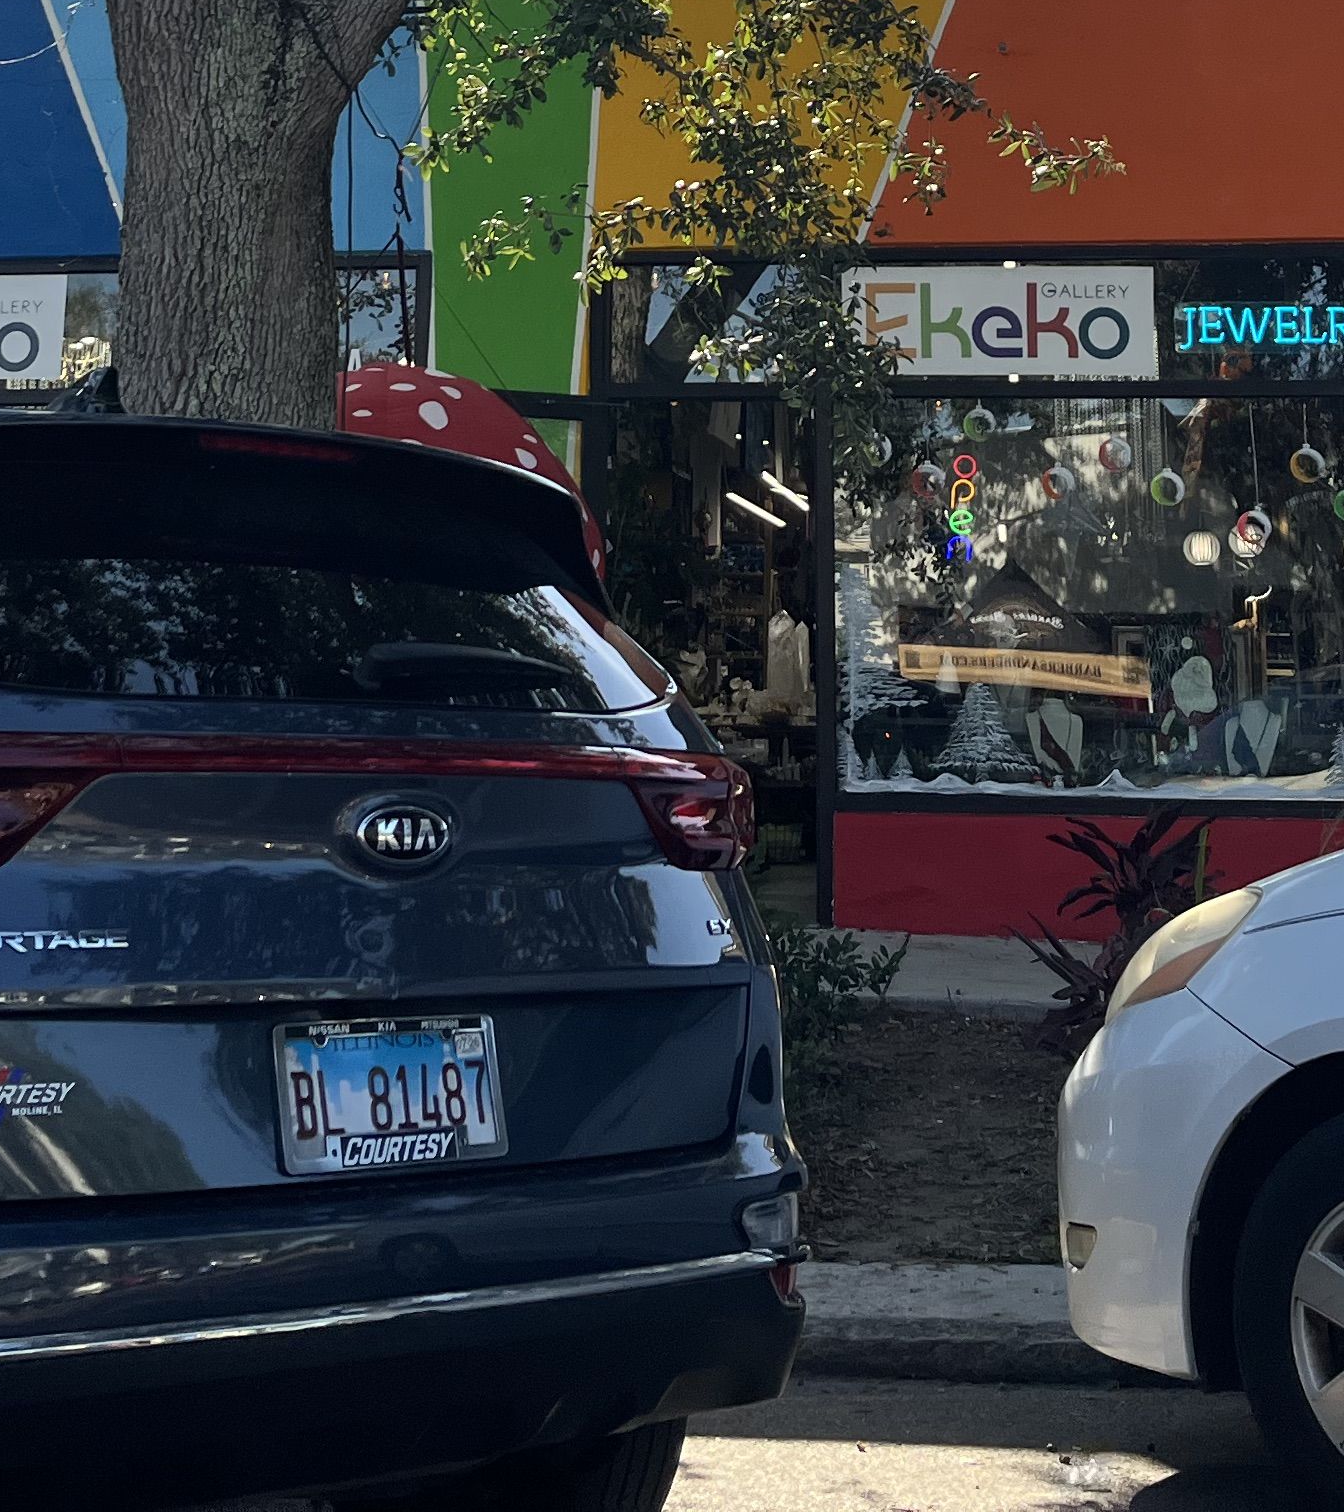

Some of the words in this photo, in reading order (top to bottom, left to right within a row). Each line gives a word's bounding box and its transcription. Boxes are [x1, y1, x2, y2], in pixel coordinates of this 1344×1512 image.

[1041, 282, 1129, 299] GALLERY
[865, 282, 1130, 360] Ekeko
[376, 818, 436, 850] KIA
[309, 1023, 350, 1036] NISSAN
[377, 1020, 396, 1032] KIA
[11, 1106, 52, 1116] MOLINE,
[290, 1070, 345, 1138] BL
[368, 1060, 485, 1132] 81487
[343, 1132, 453, 1167] COURTESY
